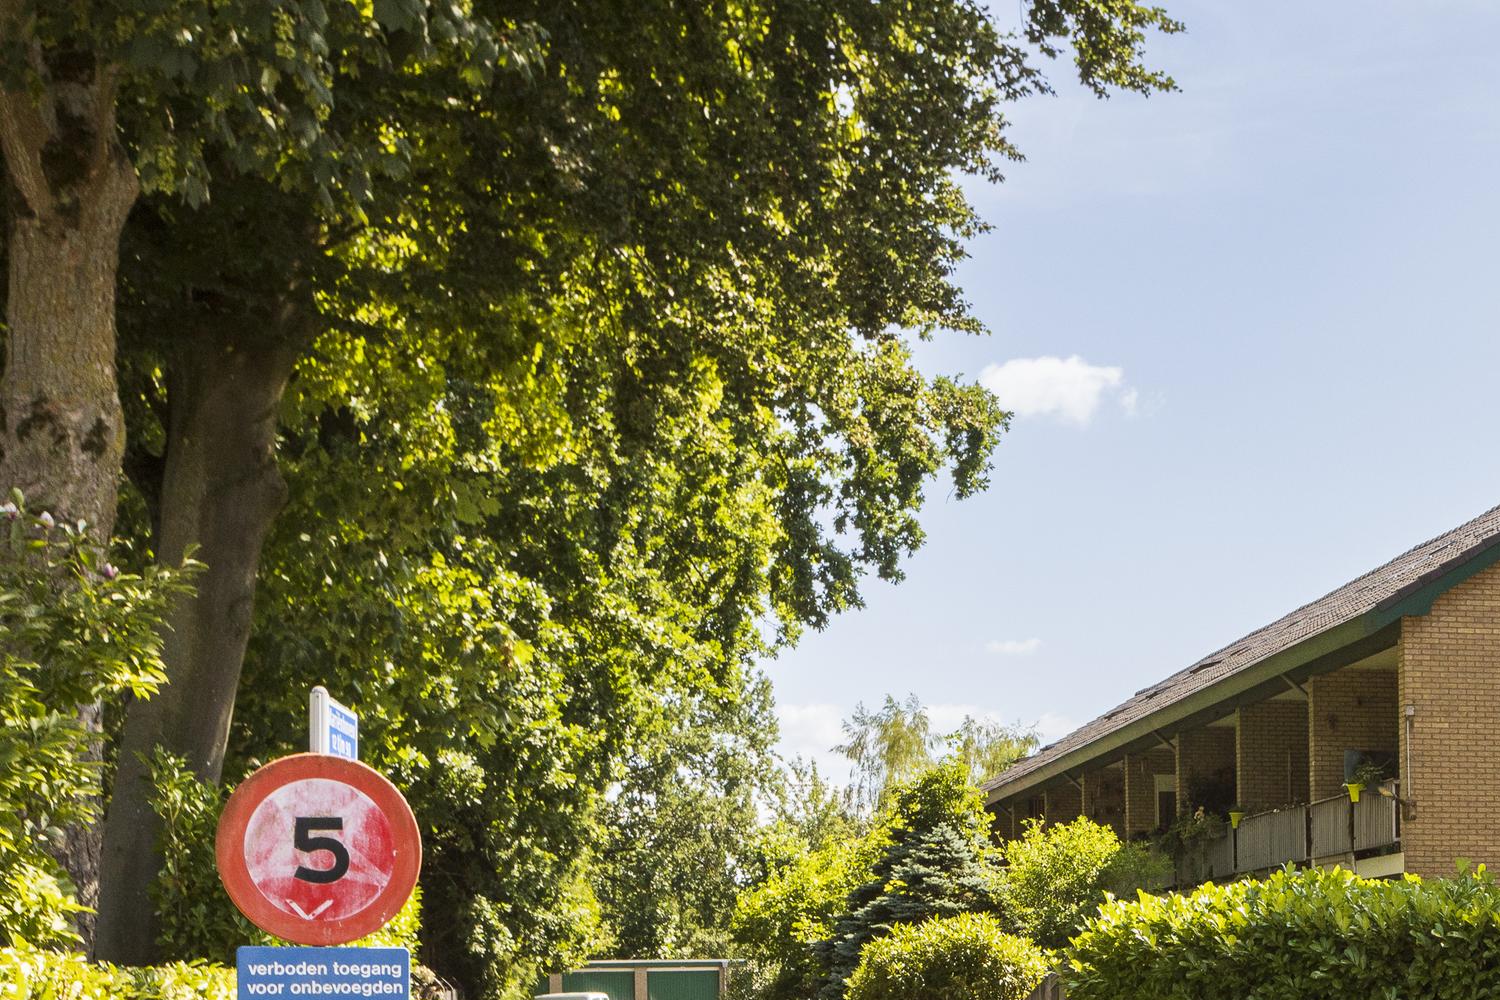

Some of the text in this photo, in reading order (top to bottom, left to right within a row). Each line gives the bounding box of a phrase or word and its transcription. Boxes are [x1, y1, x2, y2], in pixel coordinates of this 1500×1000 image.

[293, 817, 350, 884] 5
[248, 961, 402, 978] verboden toegang
[247, 980, 403, 997] voor onbevoegden
